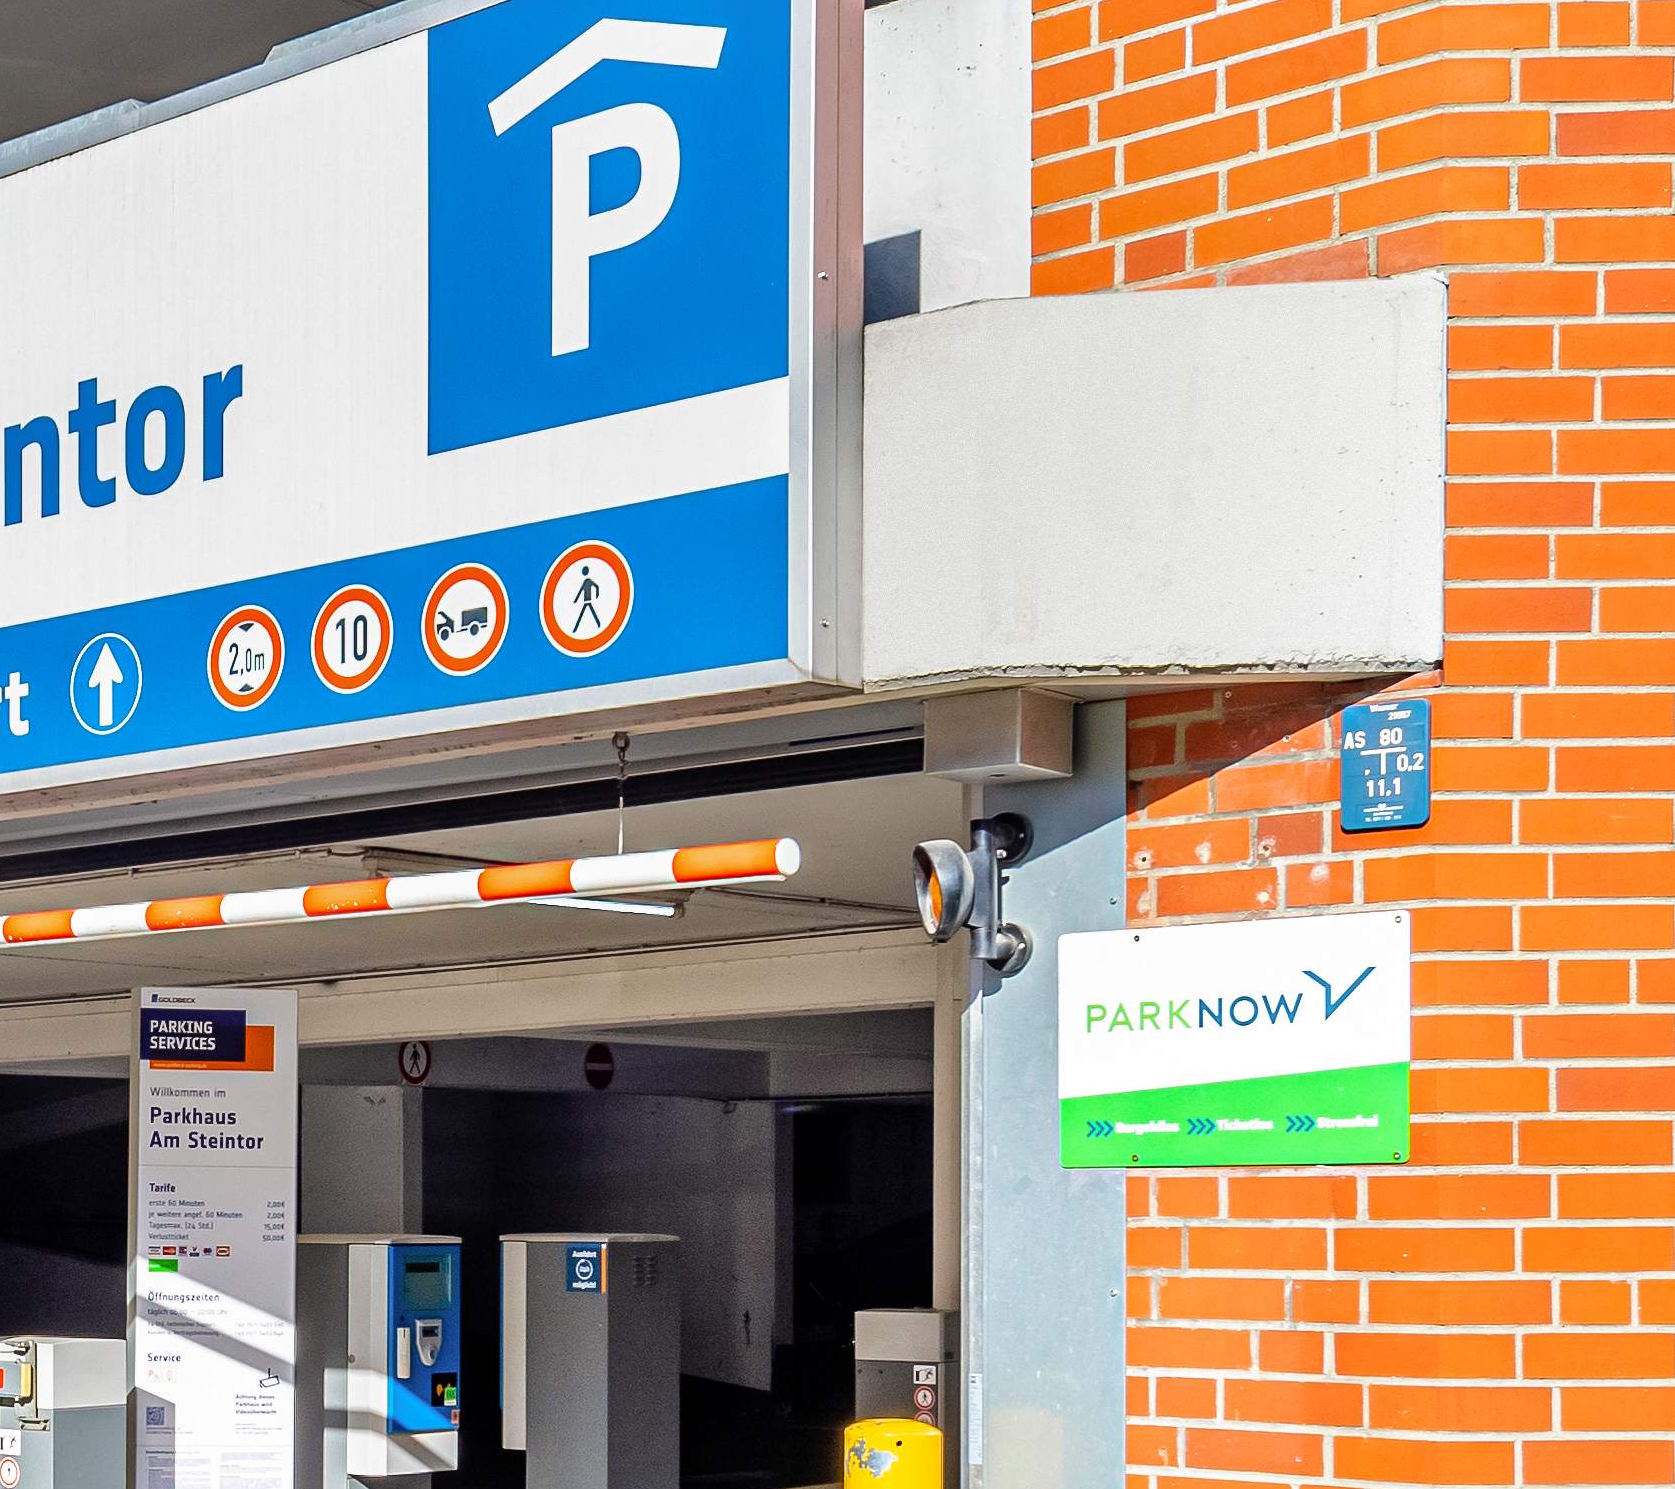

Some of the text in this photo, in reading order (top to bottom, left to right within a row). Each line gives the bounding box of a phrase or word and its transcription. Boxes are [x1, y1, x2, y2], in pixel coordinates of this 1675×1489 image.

[551, 102, 681, 358] P
[335, 611, 369, 665] 10
[1344, 727, 1402, 750] AS 80
[150, 1019, 213, 1034] PARKING
[150, 1036, 216, 1051] SERVICES
[150, 1087, 226, 1098] Willkommen im
[150, 1107, 237, 1125] Parkhaus
[149, 1130, 264, 1150] Am Steintor
[149, 1183, 176, 1192] Tarife
[147, 1291, 220, 1303] Öffnungszeiten
[147, 1352, 181, 1362] Service
